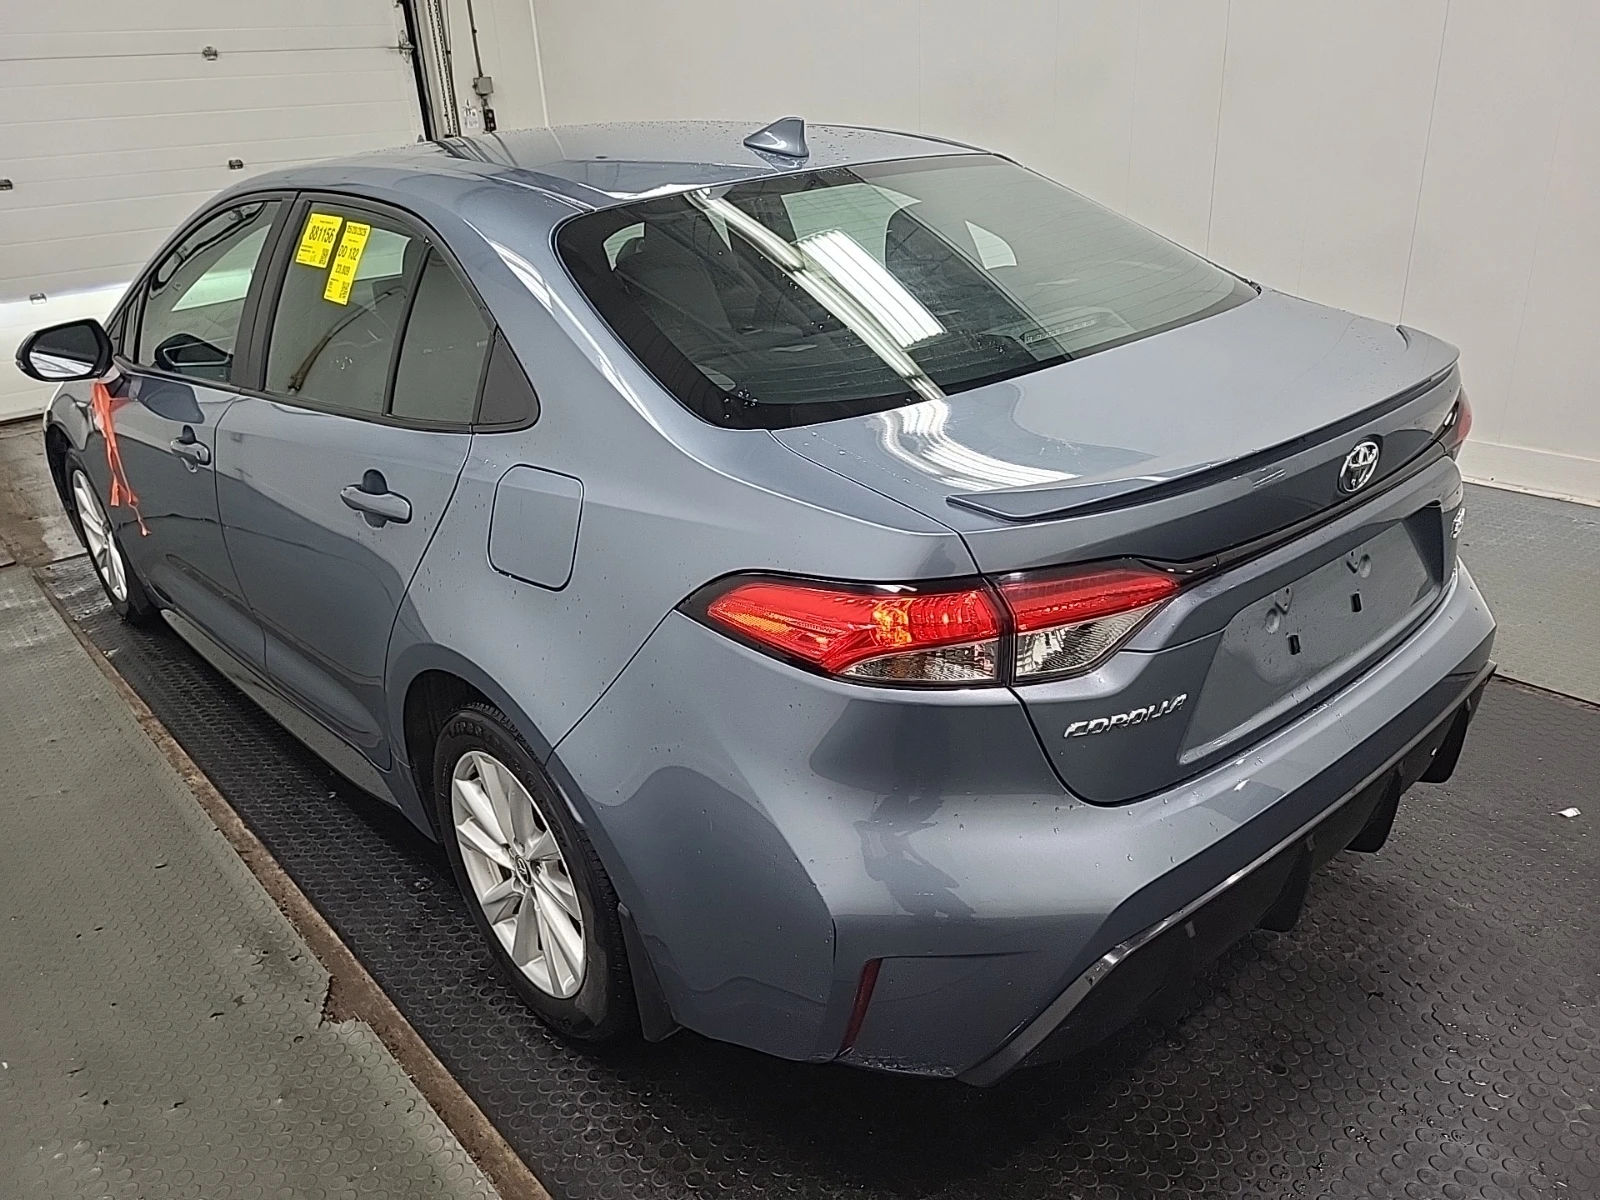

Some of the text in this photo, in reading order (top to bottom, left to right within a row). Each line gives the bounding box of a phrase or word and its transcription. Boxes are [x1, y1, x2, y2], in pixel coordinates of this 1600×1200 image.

[309, 224, 336, 244] 881156
[348, 246, 360, 261] 132
[1063, 693, 1188, 738] COROLLA
